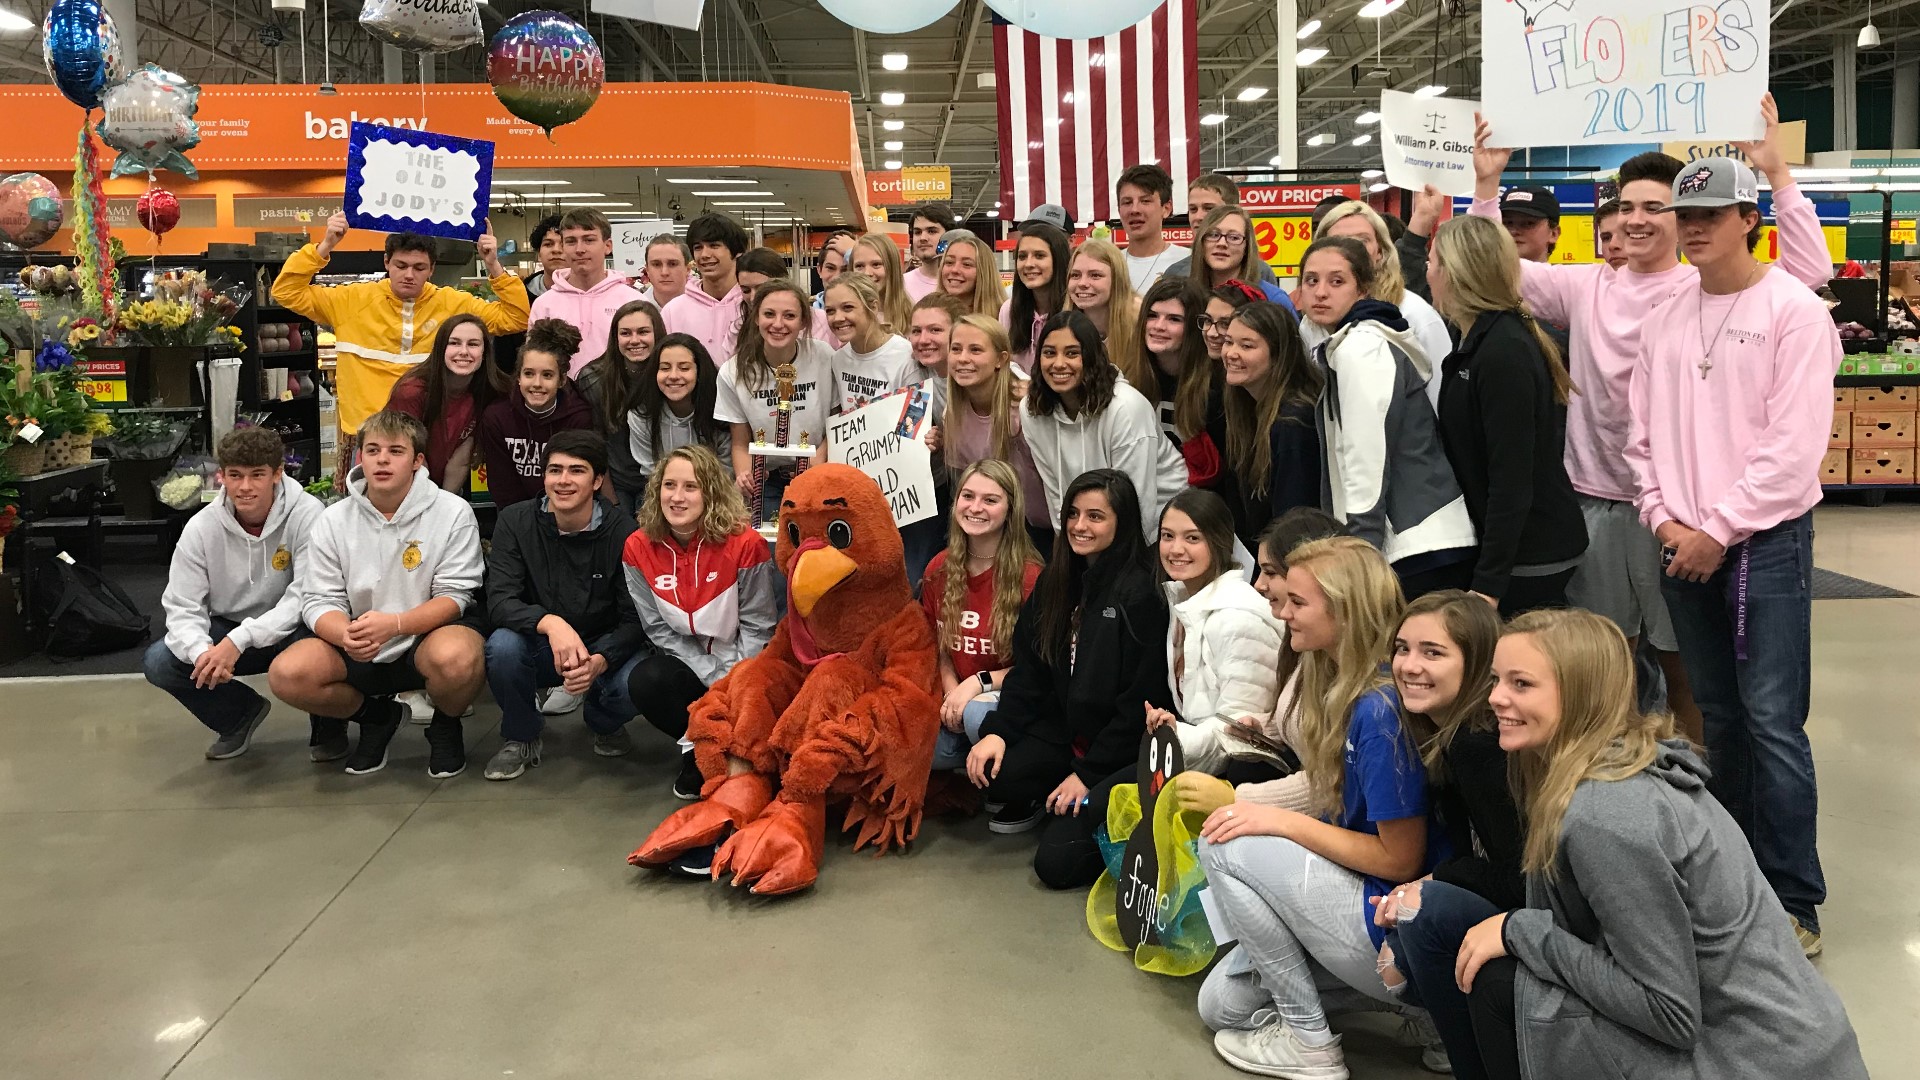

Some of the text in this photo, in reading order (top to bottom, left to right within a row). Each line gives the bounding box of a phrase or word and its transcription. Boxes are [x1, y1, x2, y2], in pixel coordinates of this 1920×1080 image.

[1525, 0, 1759, 94] FLOWERS
[516, 43, 595, 80] HAPPY
[519, 73, 591, 100] Birthday
[109, 106, 173, 123] BIRTHDAY
[1583, 82, 1706, 138] 2019
[219, 118, 250, 128] family
[486, 117, 511, 125] Made
[1394, 134, 1426, 150] William
[1429, 139, 1439, 151] P.
[405, 151, 445, 171] THE
[1404, 155, 1464, 170] Attorney at Law
[396, 169, 446, 189] OLD
[872, 178, 945, 192] tortilleria
[375, 192, 464, 216] JODY'S
[1238, 190, 1278, 203] LOW
[317, 206, 329, 217] &
[1161, 231, 1193, 240] RICES
[1726, 328, 1765, 341] BELTON FFA
[847, 382, 860, 393] OLD
[857, 375, 888, 390] GRUMPY
[831, 414, 866, 444] TEAM
[846, 430, 900, 469] GRUMPY
[1738, 548, 1749, 603] AGRICULTURE
[960, 610, 980, 629] B
[1737, 603, 1746, 636] ALUMNI
